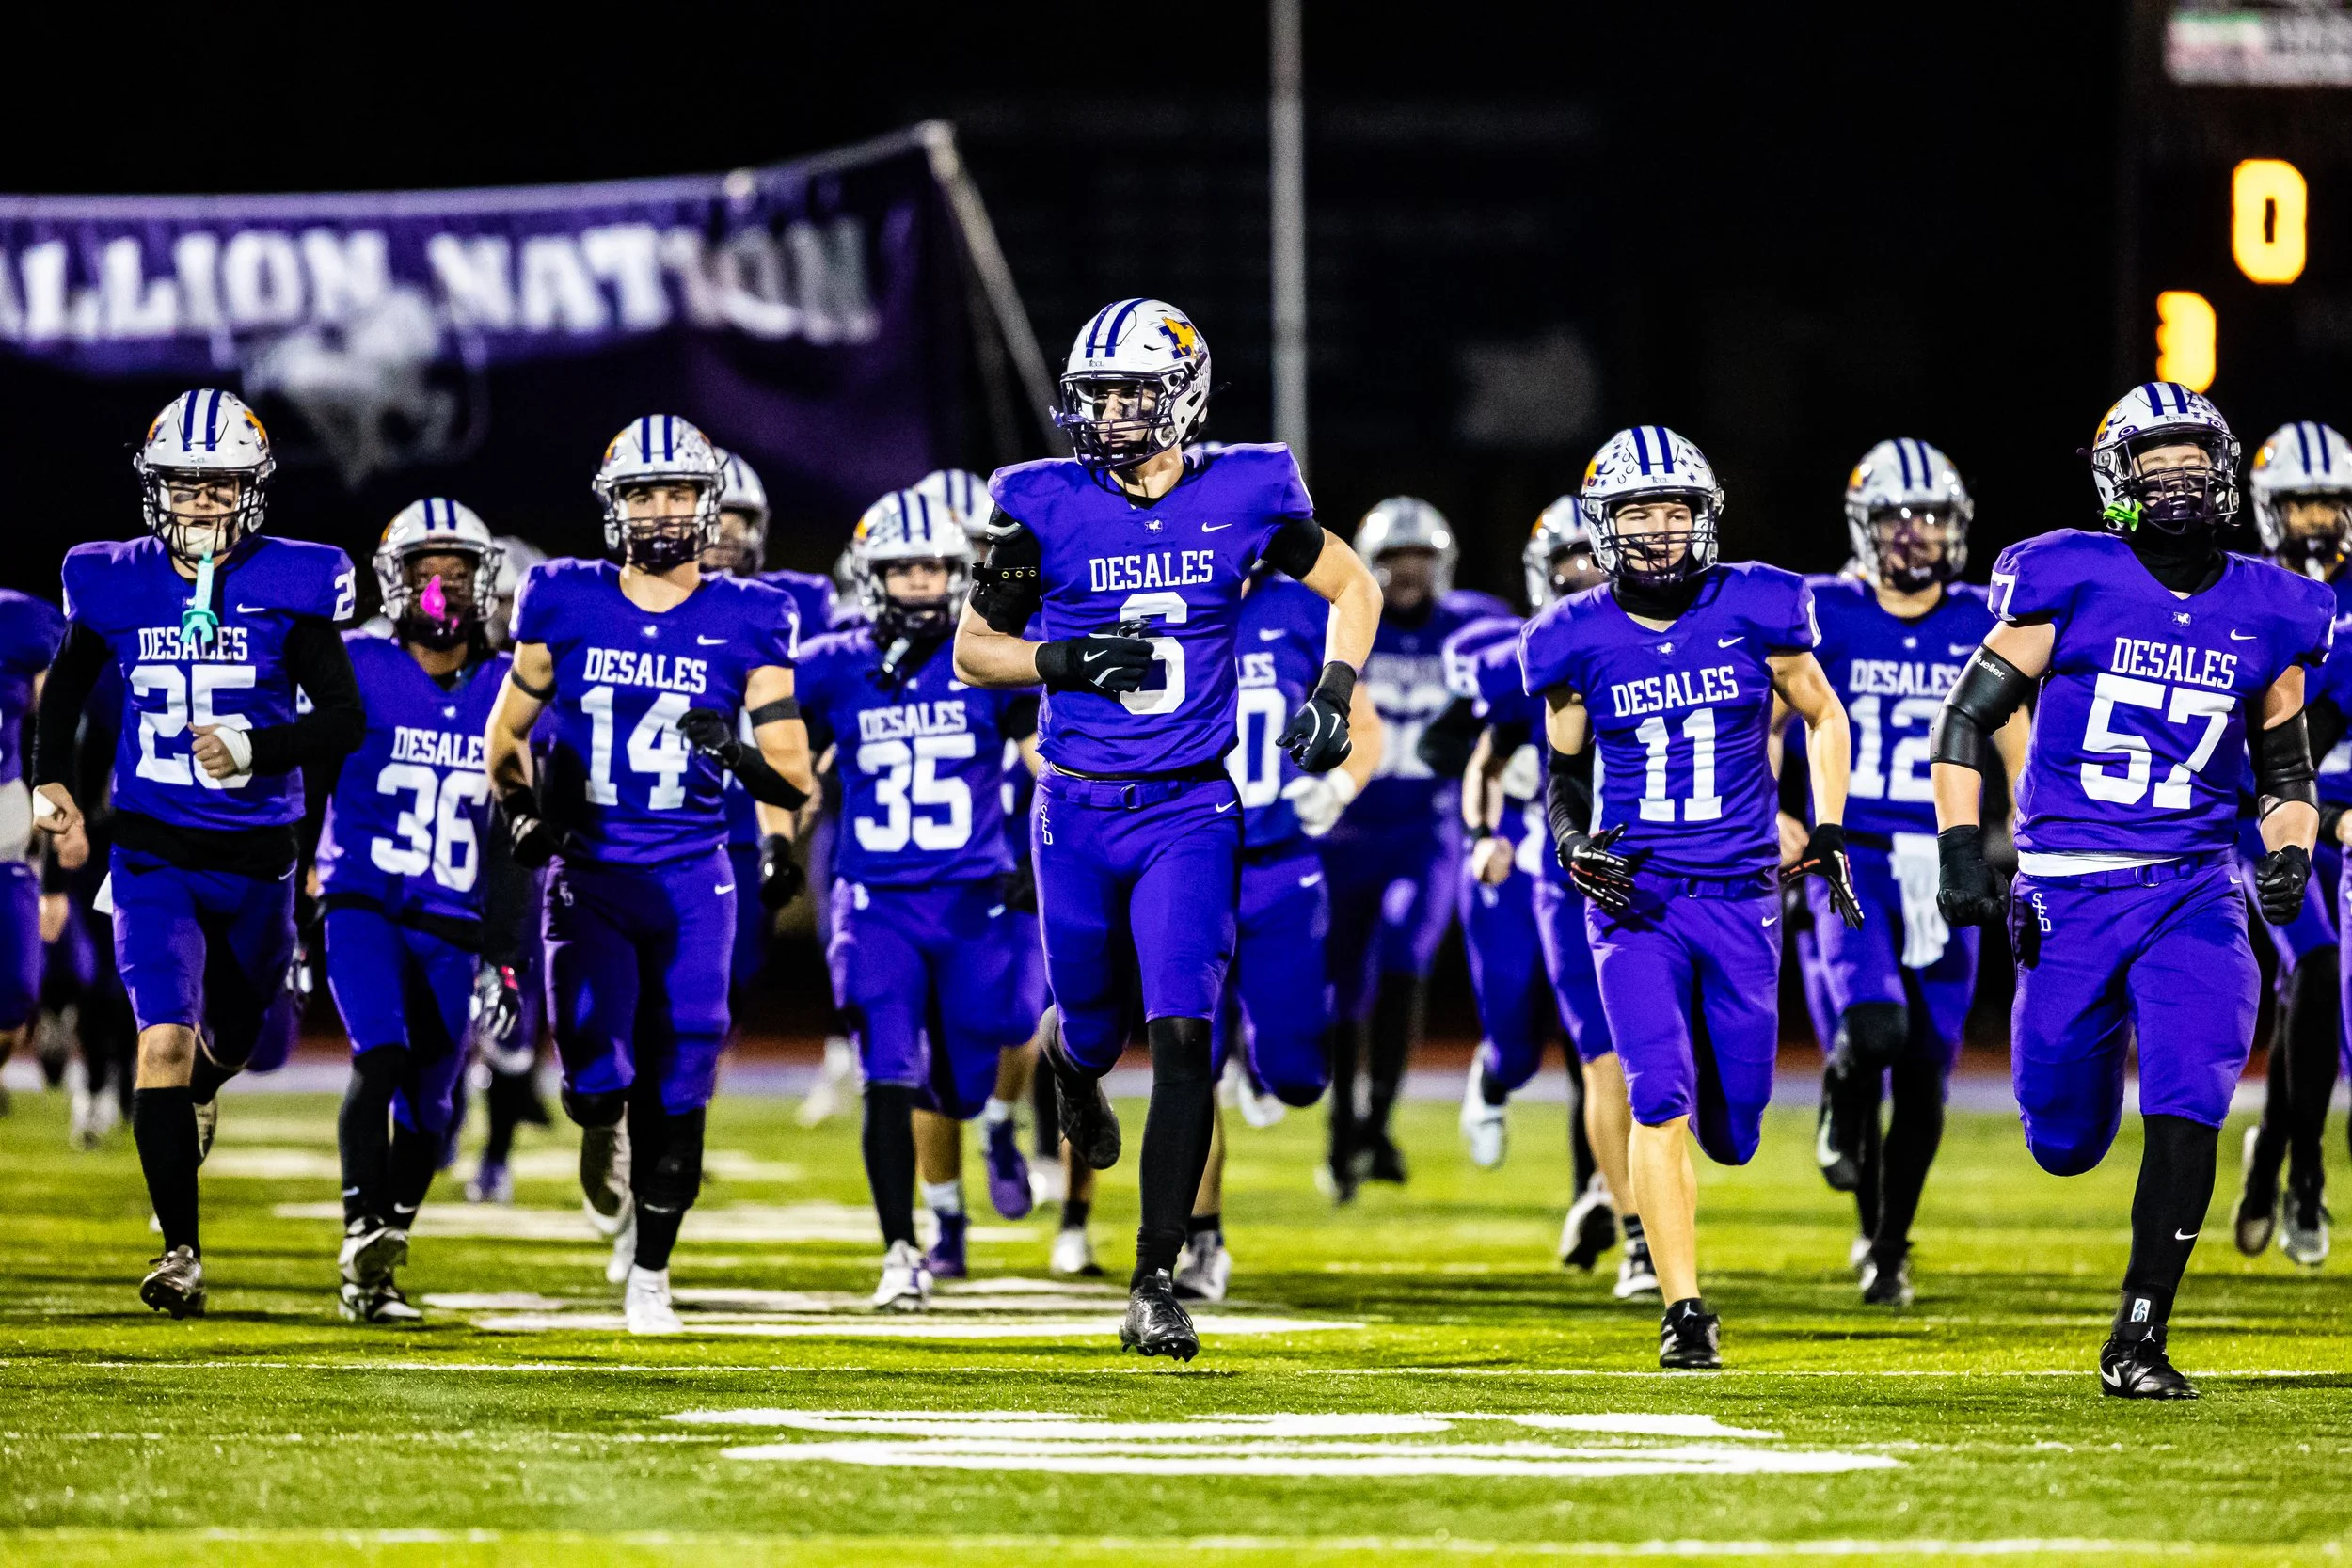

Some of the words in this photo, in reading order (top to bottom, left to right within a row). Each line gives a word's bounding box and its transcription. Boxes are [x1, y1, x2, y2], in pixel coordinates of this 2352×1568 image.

[2233, 158, 2307, 284] 0
[0, 227, 389, 343] LLION
[1089, 550, 1214, 592] DESALES
[137, 626, 248, 661] DESALES
[582, 647, 707, 694] DESALES
[1119, 591, 1187, 716] 6
[1612, 666, 1740, 718] DESALES
[1849, 659, 1962, 697] DESALES
[2110, 637, 2238, 690] DESALES
[129, 664, 256, 790] 25
[390, 726, 485, 769] DESALE
[580, 686, 691, 811] 14
[858, 701, 968, 742] DESALES
[1635, 708, 1723, 822] 11
[1847, 694, 1936, 803] 12
[2080, 673, 2236, 810] 57
[371, 763, 490, 893] 36
[854, 734, 976, 852] 35
